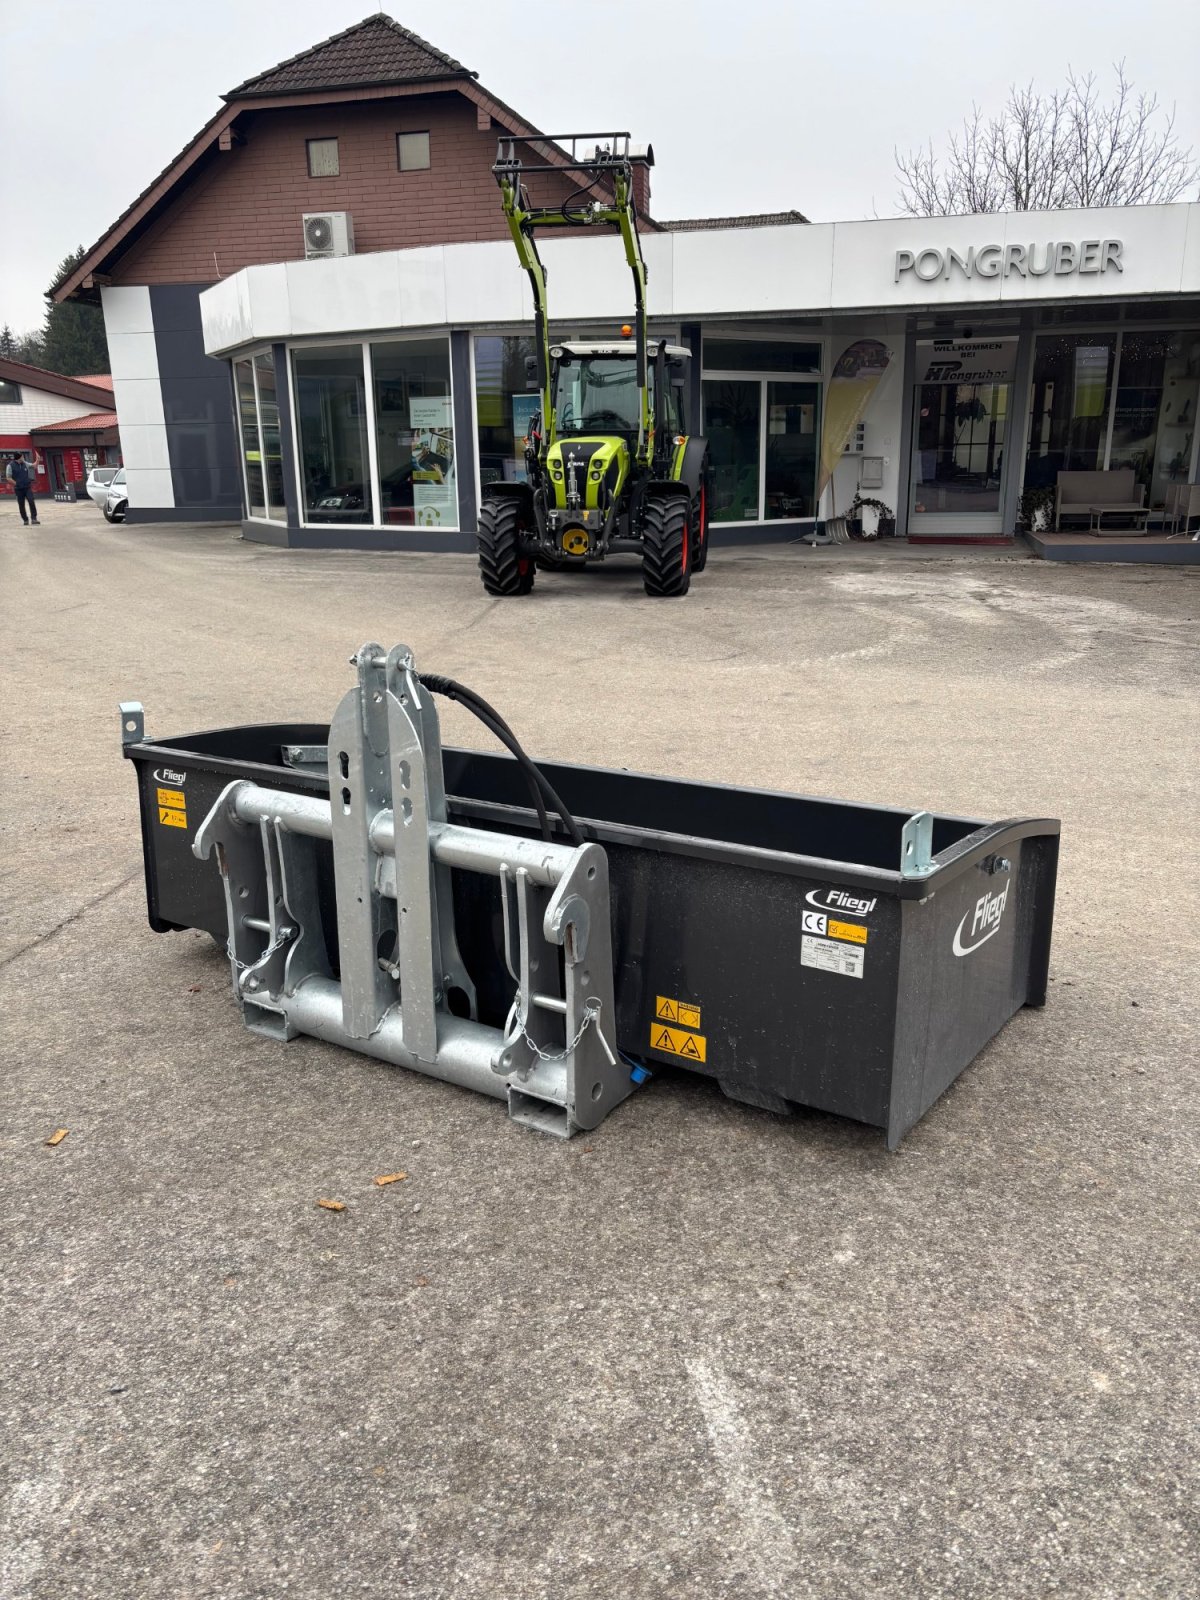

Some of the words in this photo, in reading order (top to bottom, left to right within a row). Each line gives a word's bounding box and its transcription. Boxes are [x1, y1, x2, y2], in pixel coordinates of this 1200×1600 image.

[895, 239, 1124, 283] PONGRUBER
[933, 343, 1002, 352] WILLKOMMEN
[163, 769, 187, 783] Fliegl
[826, 890, 878, 914] Fliegl
[970, 877, 1011, 937] Fliegl
[804, 914, 824, 932] CE
